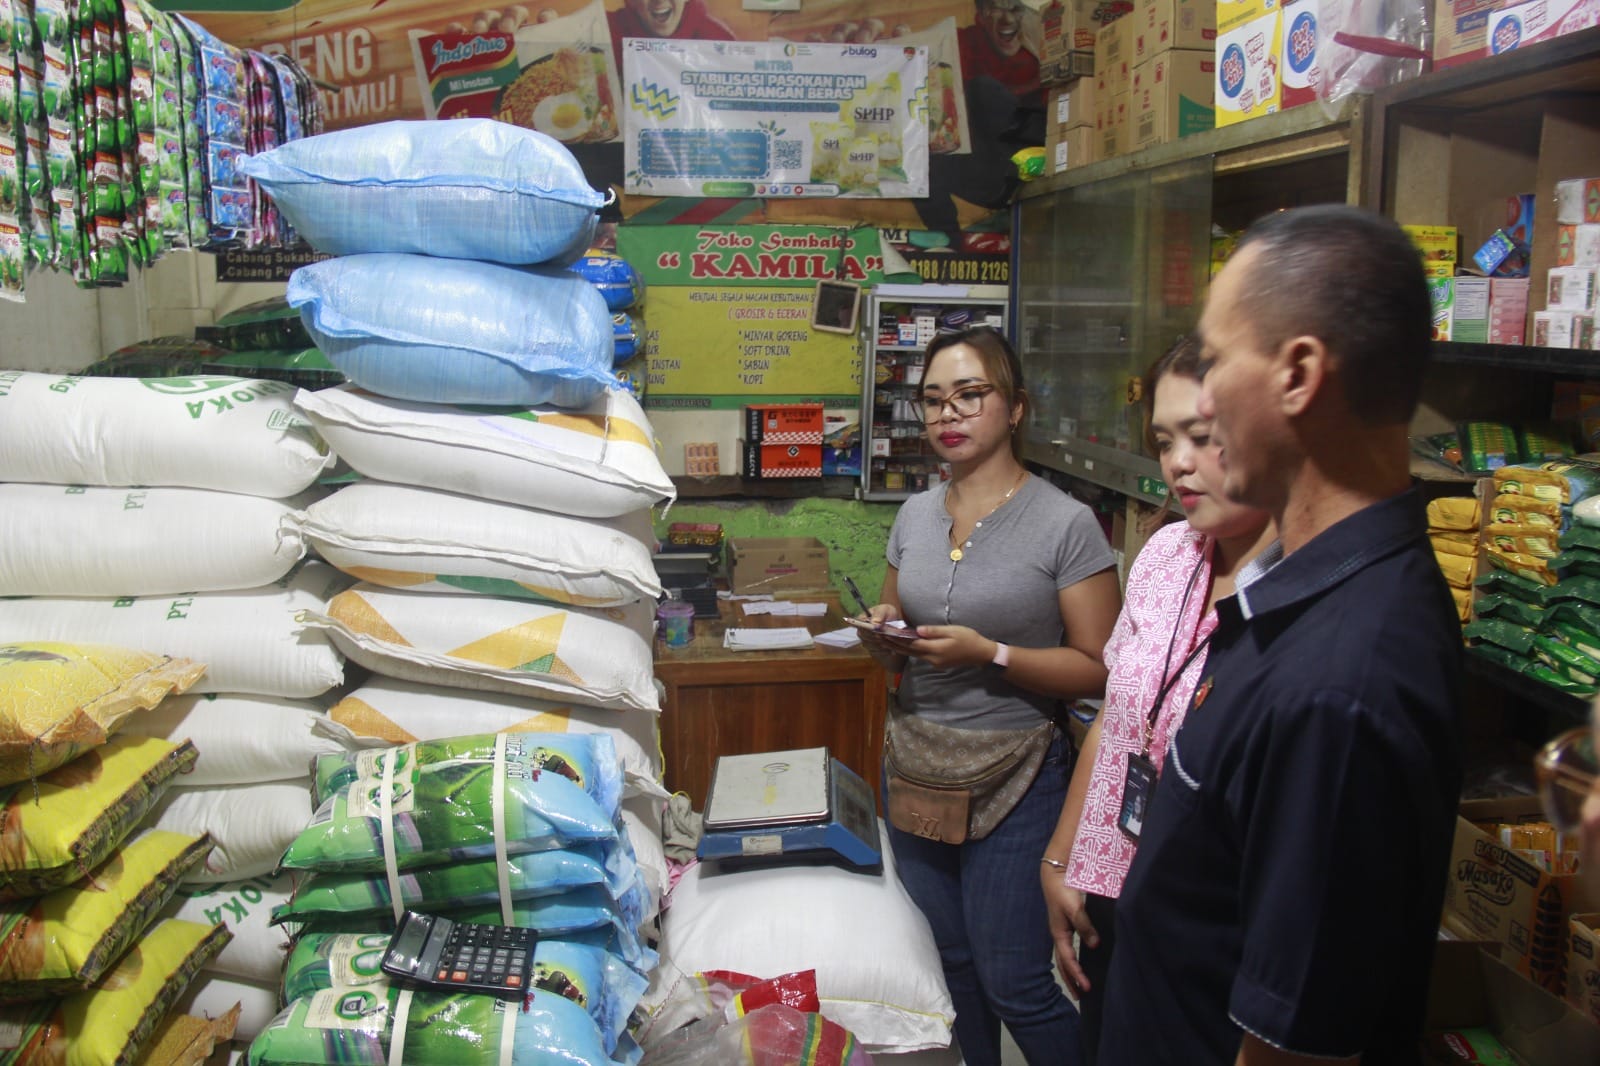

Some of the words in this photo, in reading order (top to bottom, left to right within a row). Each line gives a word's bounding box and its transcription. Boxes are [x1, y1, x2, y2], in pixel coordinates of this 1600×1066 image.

[431, 36, 507, 74] Indomie
[848, 46, 877, 58] bulog
[754, 60, 793, 71] MITRA
[682, 72, 764, 85] STABILISASI
[768, 73, 833, 87] PASOKAN
[836, 75, 866, 88] DAN
[695, 85, 744, 97] HARGA
[748, 86, 805, 98] PANGAN
[807, 87, 853, 99] BERAS
[854, 107, 895, 121] SPHP
[849, 152, 875, 161] SPHP
[697, 231, 753, 250] Toko
[760, 231, 855, 251] Sembako
[226, 252, 272, 265] Cabang
[226, 266, 272, 279] Cabang
[950, 261, 979, 281] 0878
[981, 261, 1009, 281] 2126
[689, 292, 718, 302] MENJUAL
[720, 292, 744, 302] SEGALA
[746, 292, 768, 302] MACAM
[770, 293, 810, 303] KEBUTUHAN
[735, 308, 766, 320] GROSIR
[776, 308, 807, 320] ECERAN
[744, 331, 775, 342] MINYAK
[776, 331, 808, 342] GORENG
[743, 345, 764, 356] SOFT
[765, 345, 792, 357] DRINK
[651, 359, 681, 370] INSTAN
[743, 359, 770, 371] SABUN
[743, 374, 764, 385] KOPI
[1457, 860, 1514, 894] Masako
